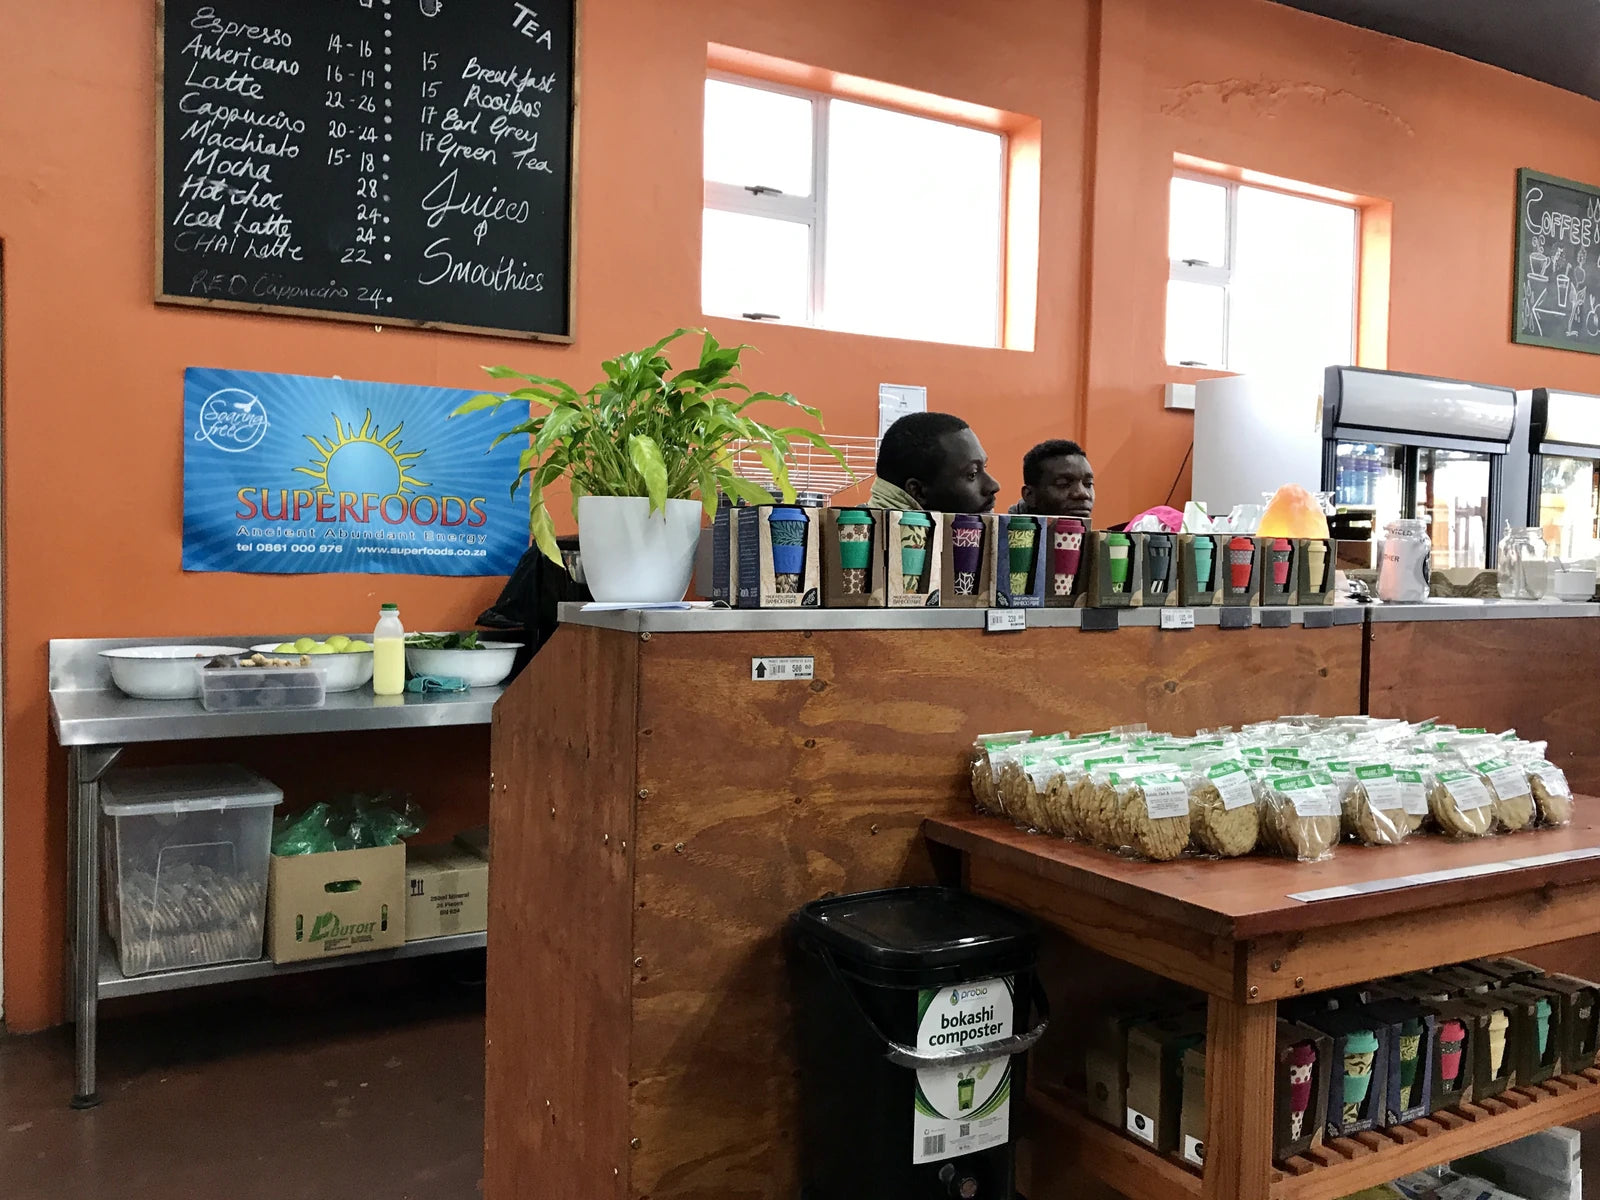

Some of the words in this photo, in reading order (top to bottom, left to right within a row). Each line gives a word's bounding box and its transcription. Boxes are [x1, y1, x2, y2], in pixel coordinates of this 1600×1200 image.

[190, 7, 291, 47] Espresso
[512, 2, 551, 50] TEA
[181, 33, 299, 75] Americano
[423, 51, 439, 71] 15
[462, 57, 556, 93] Breakfast
[184, 61, 264, 99] Latte
[422, 81, 442, 98] 15
[463, 83, 541, 118] Rooibos
[179, 92, 305, 132] Cappuccino
[421, 106, 437, 124] 17
[441, 108, 481, 134] Earl
[489, 115, 538, 148] Grey
[180, 120, 299, 158] Macchiato
[420, 131, 435, 151] 17
[436, 133, 497, 168] Green
[512, 148, 552, 173] Tea
[184, 148, 272, 183] Mocha
[357, 177, 377, 198] 28
[179, 174, 226, 201] Hot
[357, 204, 381, 224] 24
[422, 168, 529, 228] Juices
[1525, 187, 1592, 247] COFFEE
[173, 201, 225, 230] Iced
[234, 208, 292, 237] Latte
[356, 227, 376, 245] 24
[341, 248, 372, 264] 22
[418, 237, 544, 292] Smoothies
[357, 288, 384, 309] 24
[204, 400, 267, 441] Soaring
[235, 487, 487, 528] SUPERFOODS
[235, 525, 316, 538] Ancient
[324, 527, 416, 541] Abundant
[423, 531, 487, 544] Energy
[236, 543, 253, 553] tel
[256, 543, 287, 553] 0861
[291, 544, 316, 554] 000
[319, 544, 343, 554] 976
[357, 545, 487, 557] www.superfoods.co.za
[961, 987, 988, 1000] probio
[929, 1022, 1003, 1046] composter
[941, 1004, 994, 1029] bokashi
